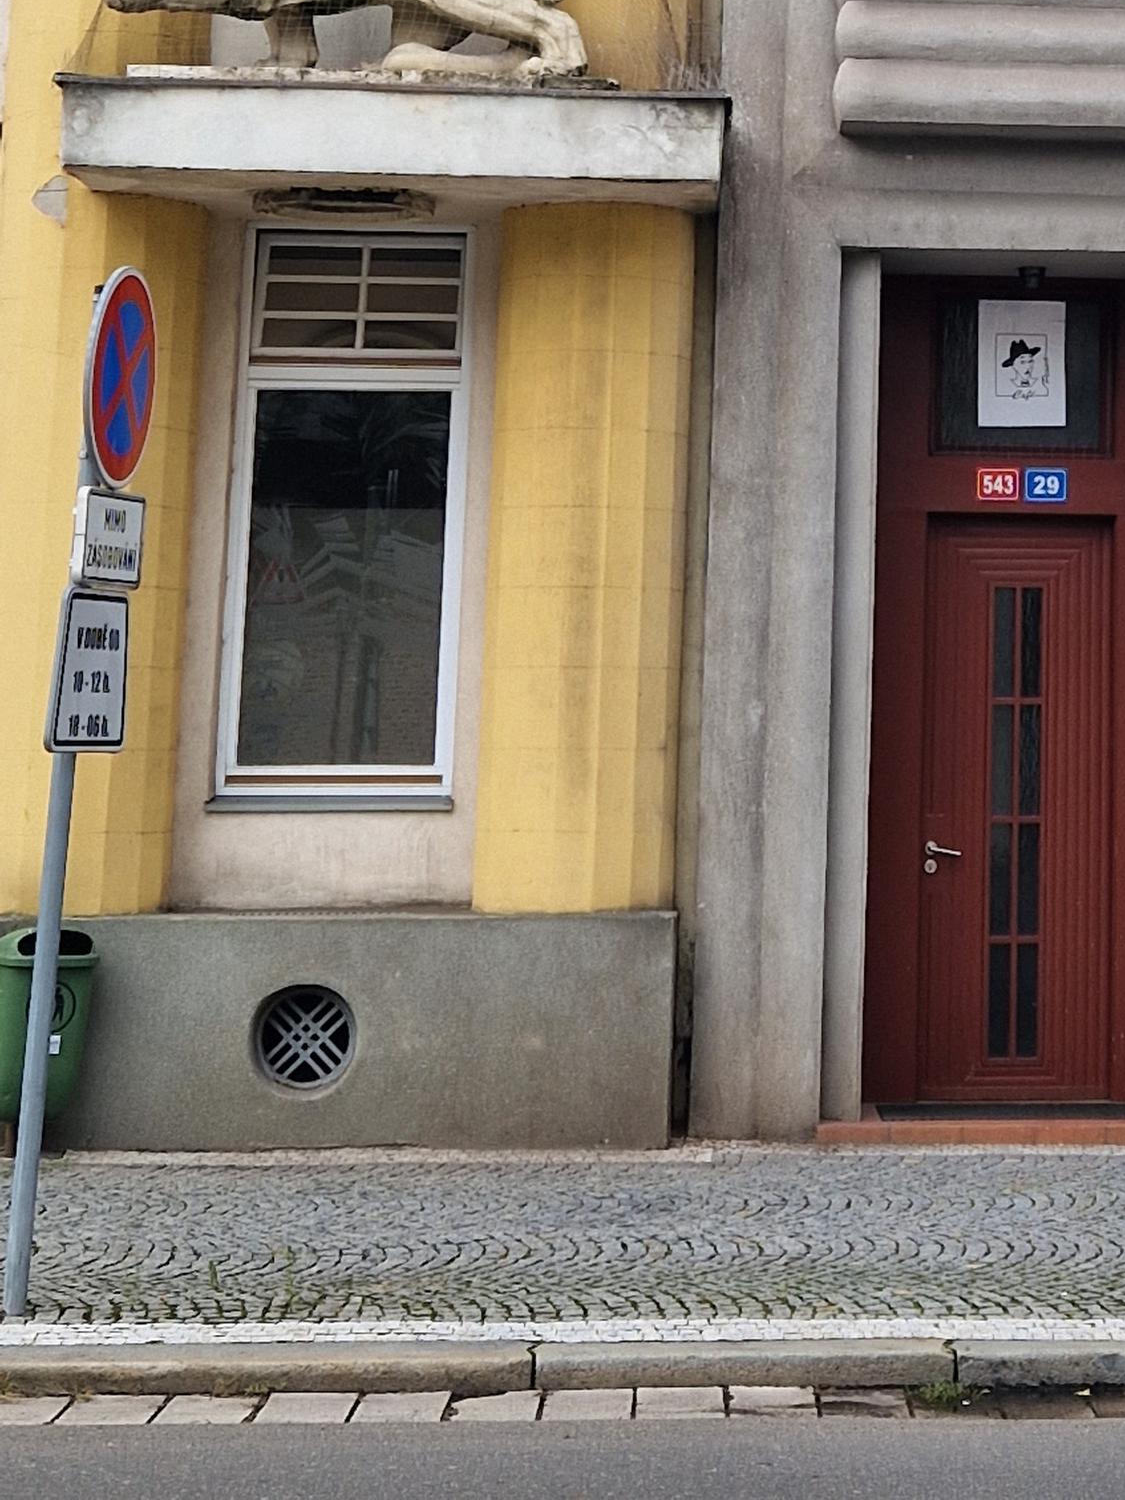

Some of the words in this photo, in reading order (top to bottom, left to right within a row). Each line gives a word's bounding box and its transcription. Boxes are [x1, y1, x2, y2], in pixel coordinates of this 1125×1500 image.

[983, 474, 1014, 495] 543
[1033, 475, 1060, 495] 29
[103, 508, 126, 533] MIMO
[86, 538, 137, 572] ZÁSOBOVÁNÍ
[77, 626, 84, 650] V
[84, 624, 107, 650] DOBĚ
[109, 628, 120, 651] OD
